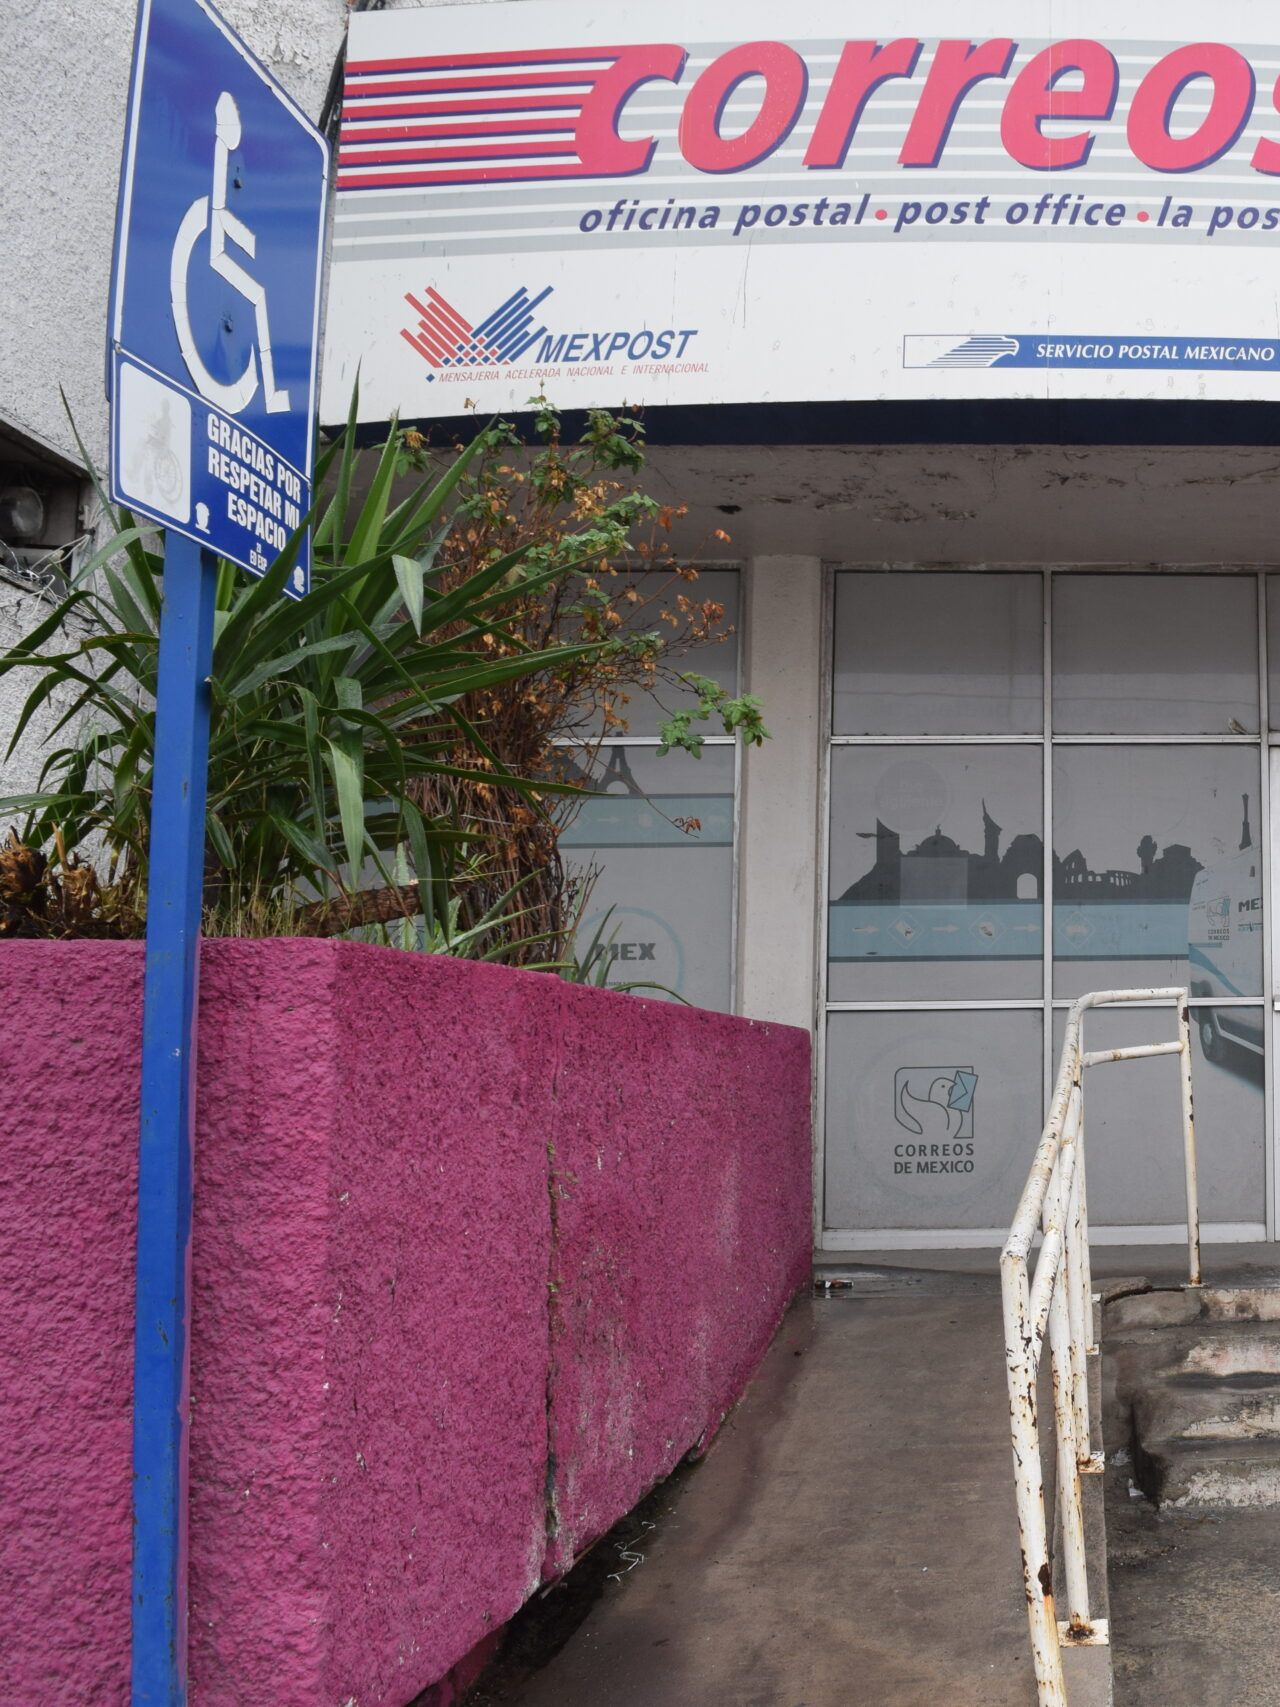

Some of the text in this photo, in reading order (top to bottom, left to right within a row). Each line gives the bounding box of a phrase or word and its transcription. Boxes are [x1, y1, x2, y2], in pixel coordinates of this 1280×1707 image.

[579, 198, 718, 232] oficina
[733, 193, 866, 235] postal
[894, 196, 989, 232] post
[1005, 193, 1127, 227] office
[1156, 196, 1194, 227] la
[535, 330, 698, 363] MEXPOST
[1036, 343, 1275, 361] SERVICIO POSTAL MEXICANO
[438, 363, 710, 383] MENSAJERIA ACELERADA NACIONAL E INTERNACIONAL
[207, 413, 301, 504] GRACIAS POR
[208, 446, 300, 531] RESPETAR MI
[228, 492, 286, 552] ESPACIO
[1238, 897, 1263, 912] ME
[894, 1143, 974, 1157] CORREOS
[894, 1160, 974, 1174] DE MEXICO
